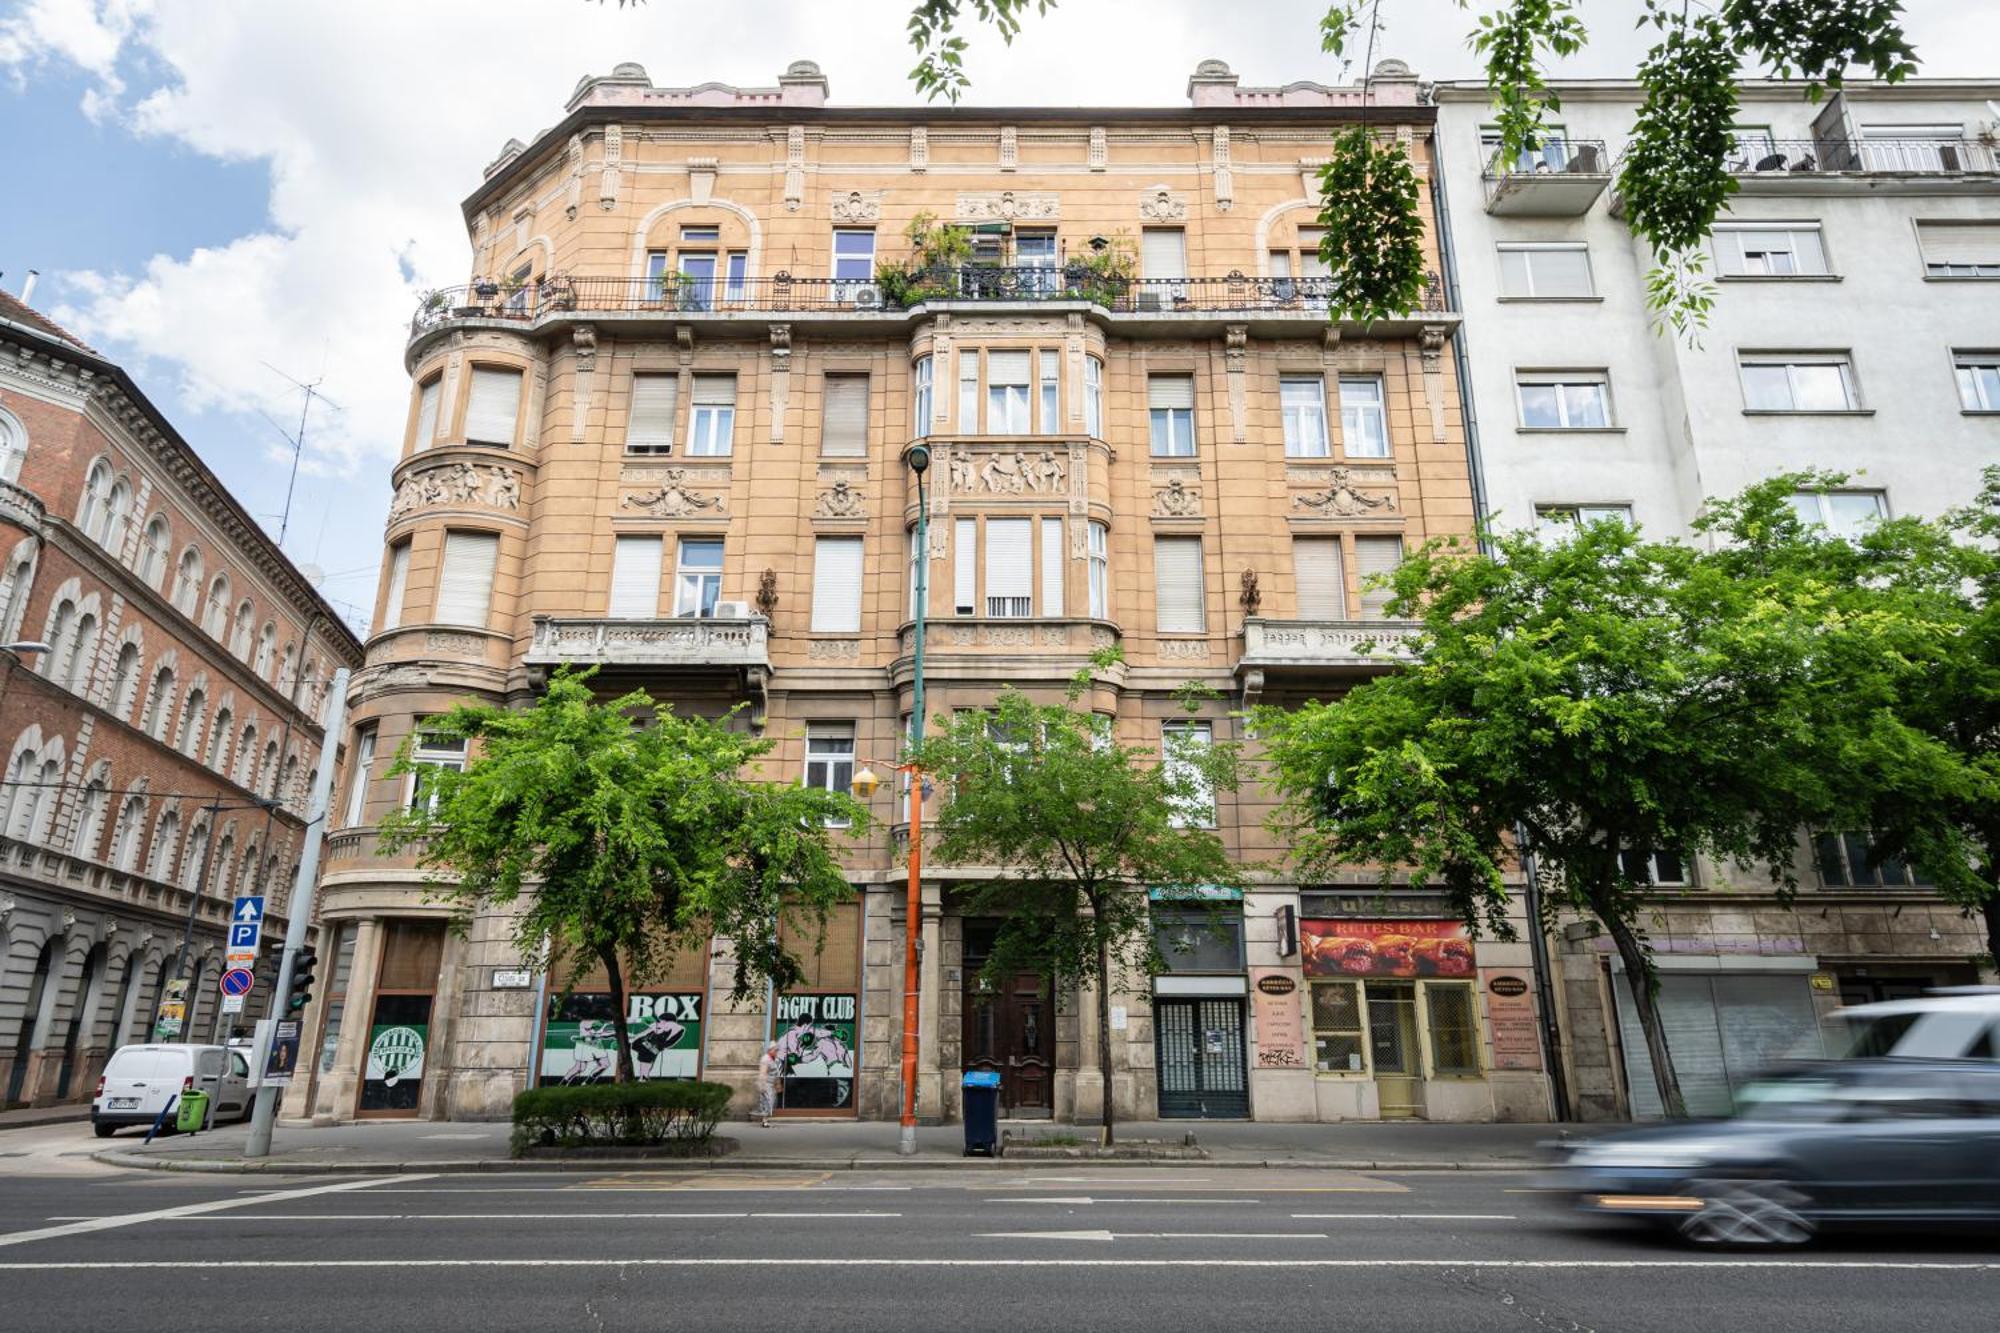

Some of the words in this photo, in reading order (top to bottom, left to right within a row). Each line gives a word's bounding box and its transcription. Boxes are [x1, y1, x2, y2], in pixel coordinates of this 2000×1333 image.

[236, 927, 252, 944] P
[629, 995, 701, 1021] BOX
[776, 996, 819, 1020] FIGHT
[822, 996, 855, 1020] CLUB
